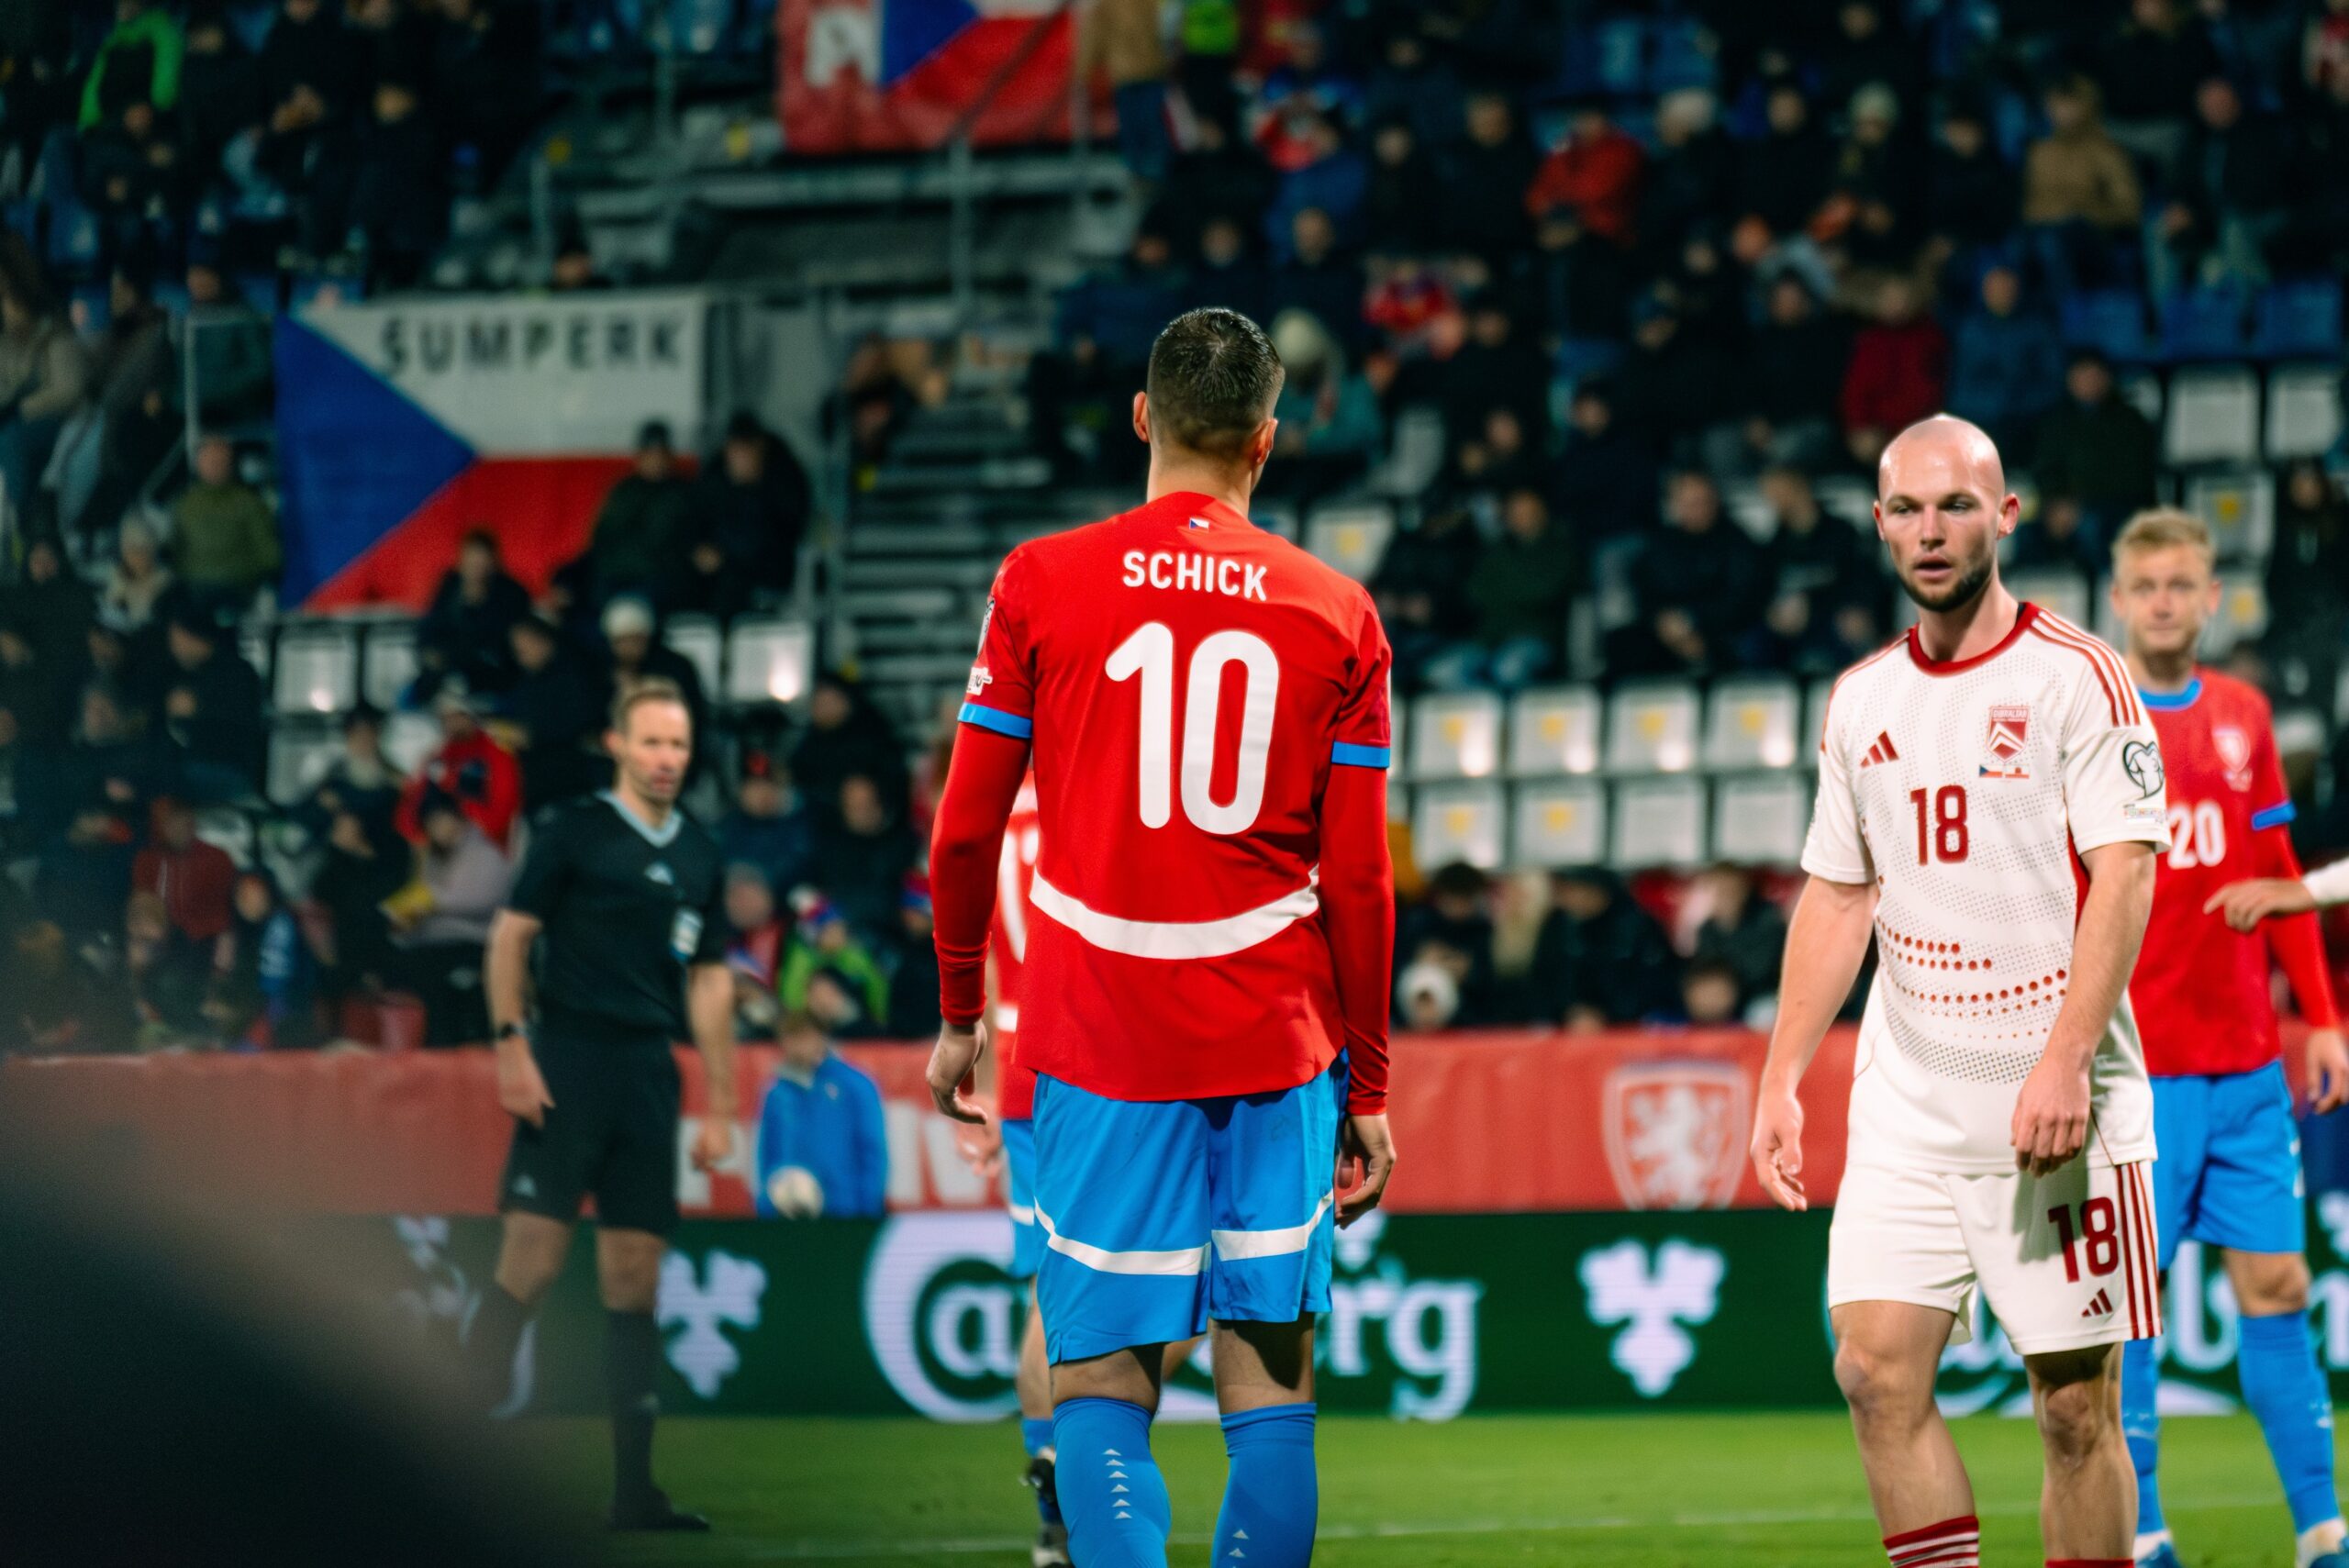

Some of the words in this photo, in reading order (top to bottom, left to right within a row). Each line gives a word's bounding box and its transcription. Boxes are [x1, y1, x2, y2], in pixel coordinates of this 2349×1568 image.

[1122, 550, 1268, 602] SCHICK
[1105, 621, 1280, 835] 10
[1909, 784, 1969, 866] 18
[2167, 799, 2227, 870] 20
[2047, 1196, 2120, 1284] 18
